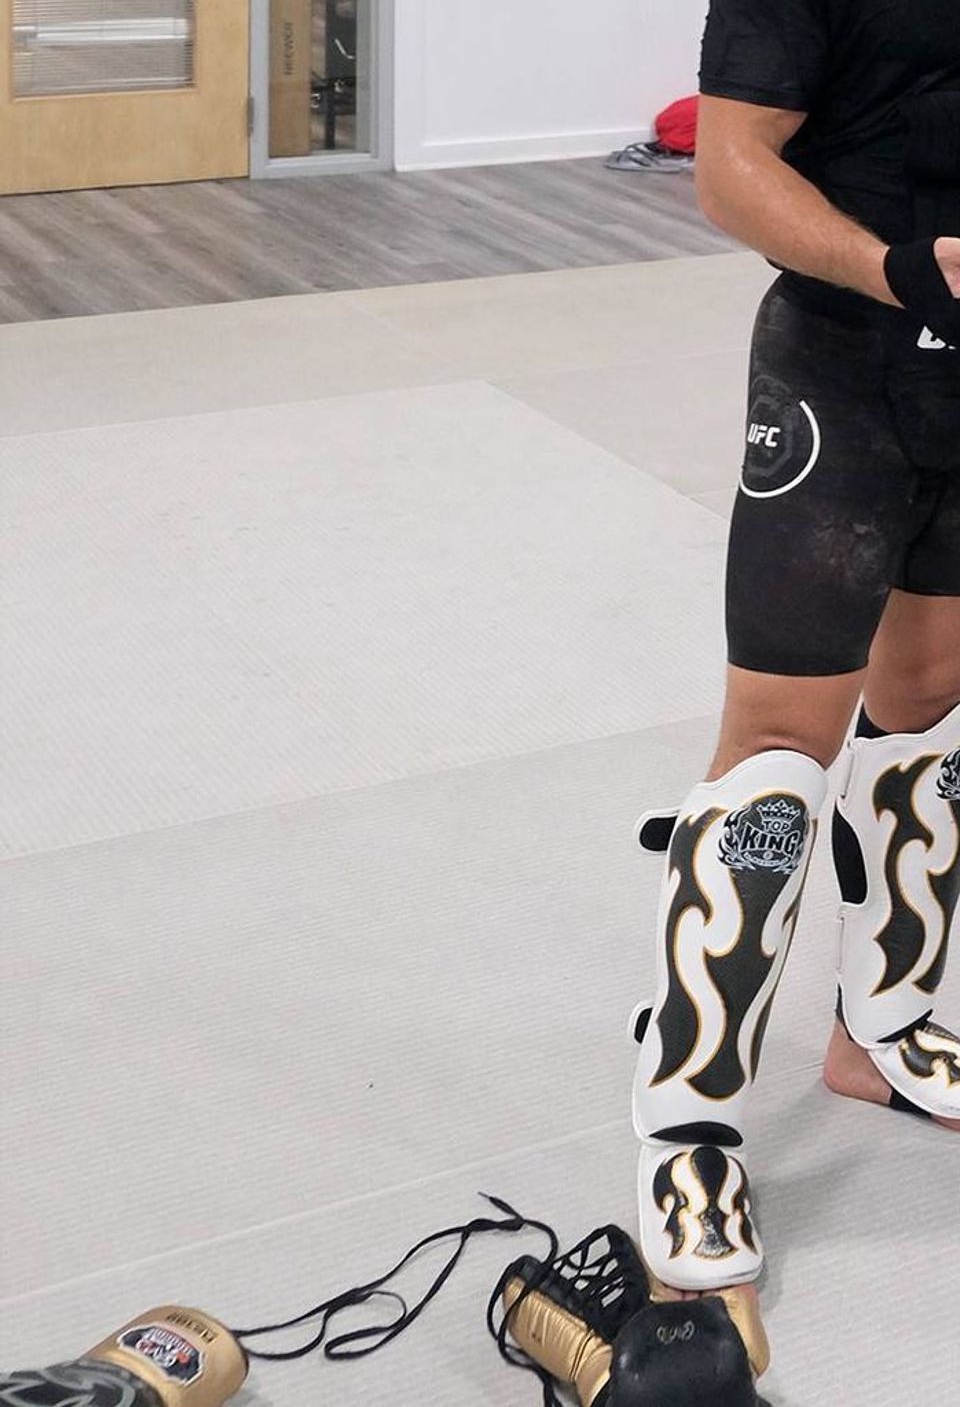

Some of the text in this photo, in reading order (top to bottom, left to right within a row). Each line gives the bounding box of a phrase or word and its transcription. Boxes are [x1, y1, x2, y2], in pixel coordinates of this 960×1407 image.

[747, 423, 781, 448] UFC
[762, 819, 791, 832] TOP
[739, 822, 800, 857] KING
